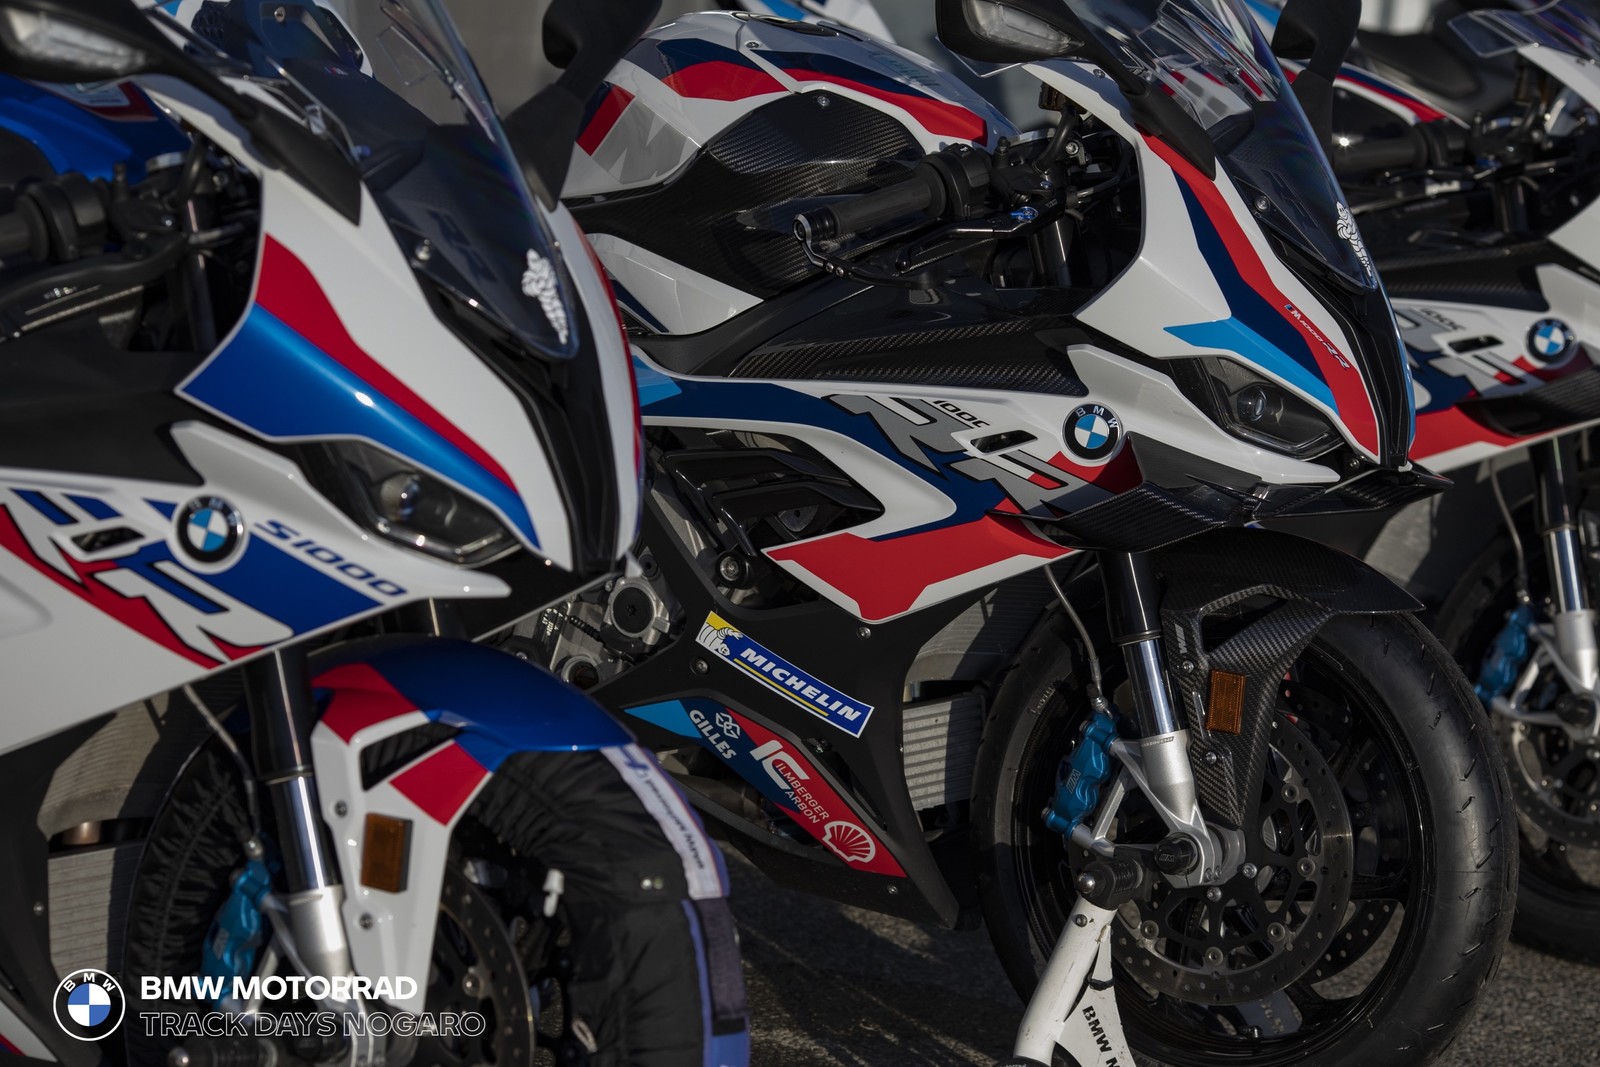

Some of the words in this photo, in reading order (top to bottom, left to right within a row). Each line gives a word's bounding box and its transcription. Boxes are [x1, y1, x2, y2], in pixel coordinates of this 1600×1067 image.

[254, 520, 408, 596] S1000
[740, 647, 862, 722] MICHELIN
[688, 709, 737, 761] GILLES
[775, 763, 830, 821] ILMBERGER
[1082, 1005, 1112, 1053] BMW
